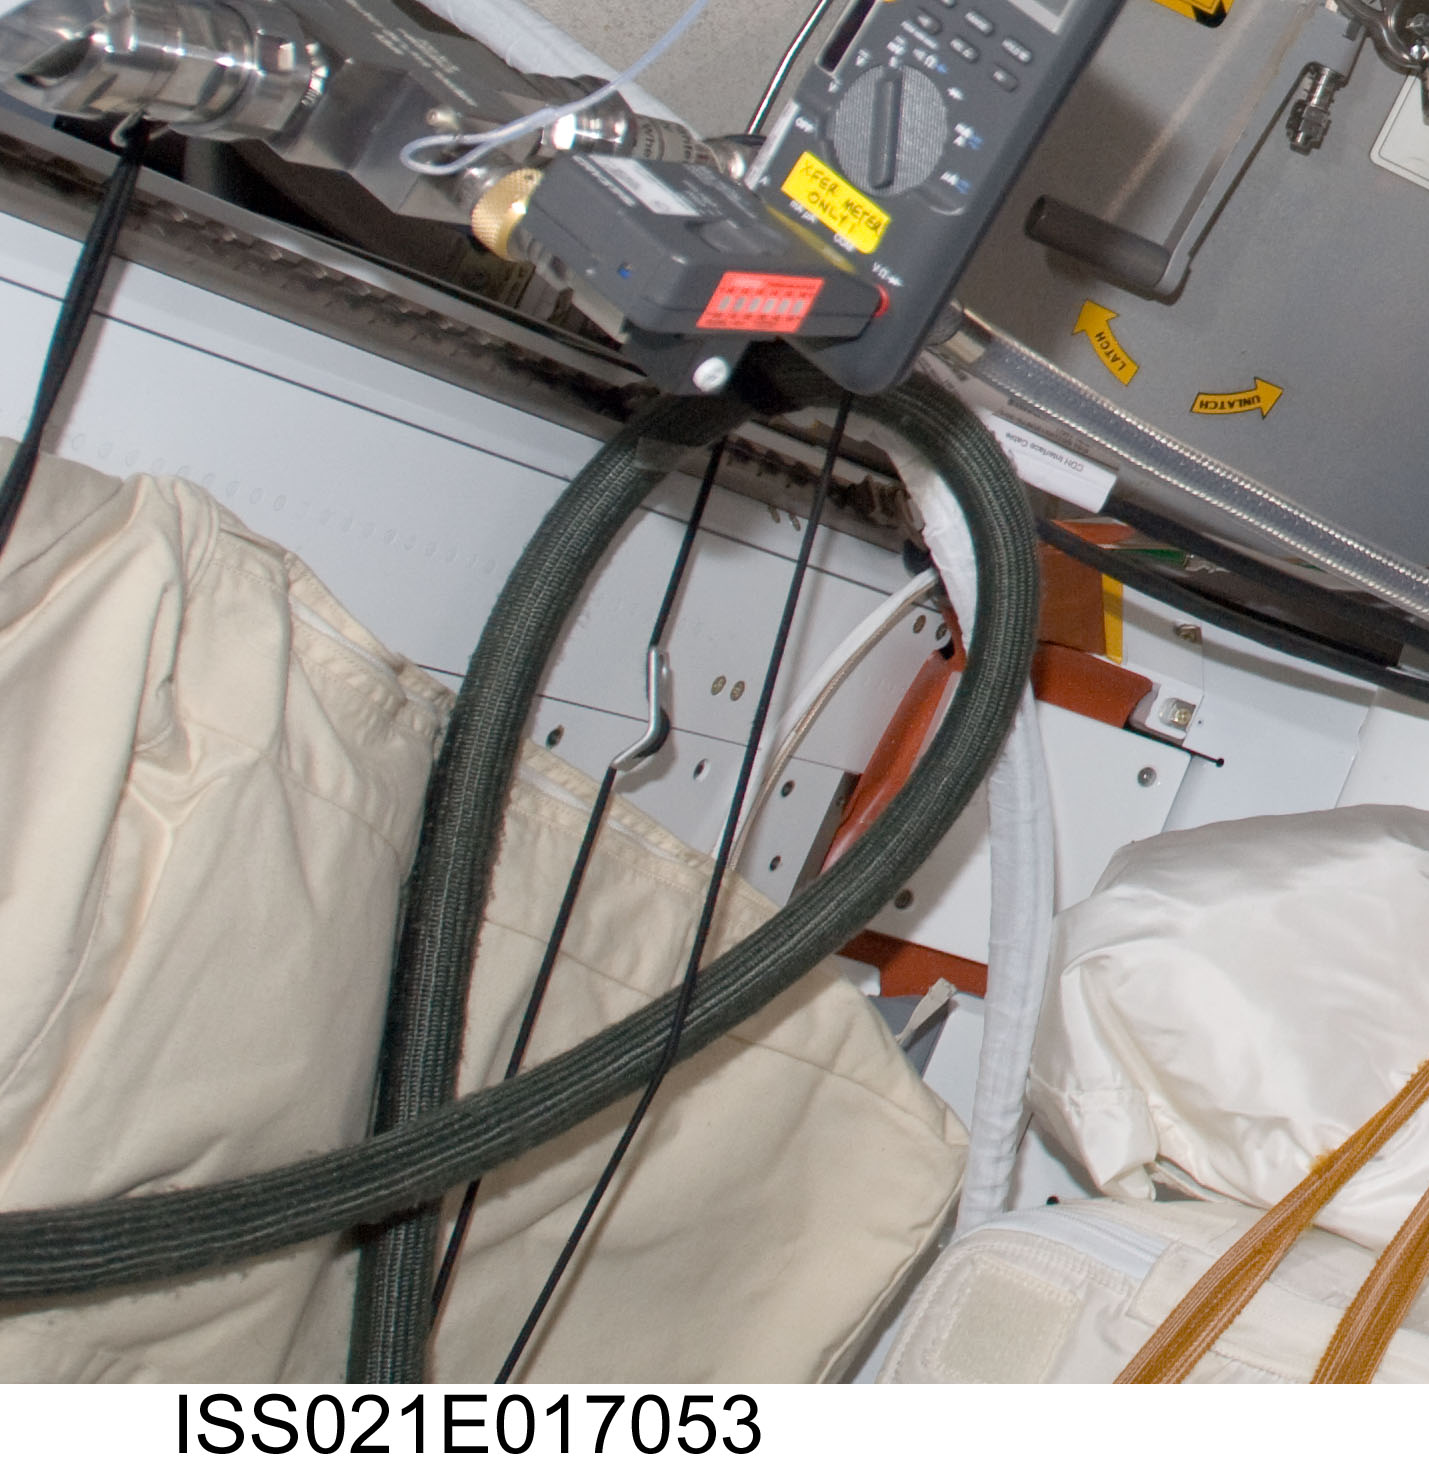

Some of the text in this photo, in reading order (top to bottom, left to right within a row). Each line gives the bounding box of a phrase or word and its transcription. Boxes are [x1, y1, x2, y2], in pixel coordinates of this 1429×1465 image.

[799, 160, 884, 233] XFER METER
[1095, 331, 1126, 371] LATCH
[1197, 394, 1261, 409] UNLATCH
[1002, 431, 1029, 448] Cable
[1027, 442, 1064, 464] Interface
